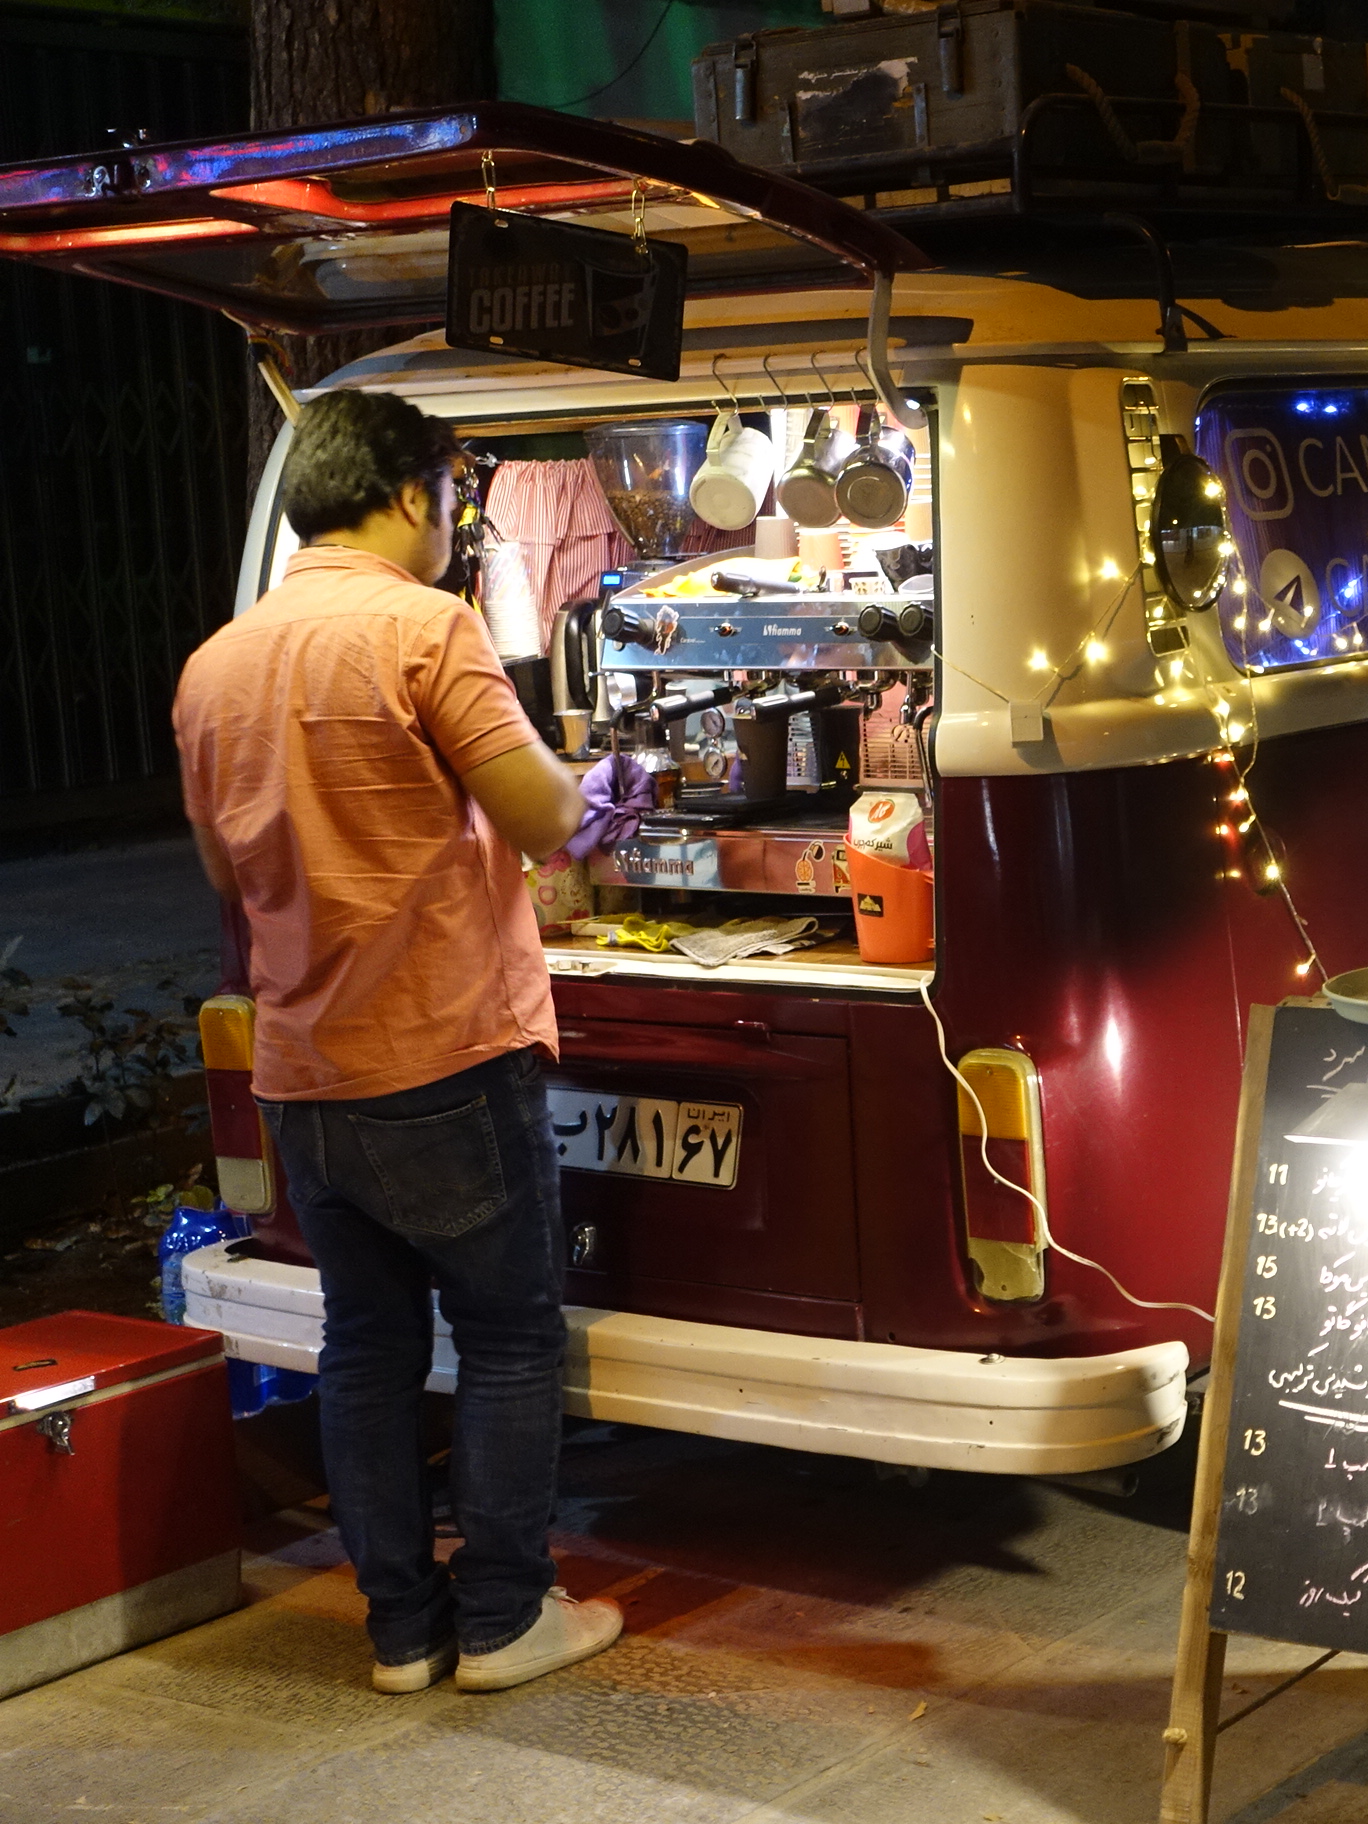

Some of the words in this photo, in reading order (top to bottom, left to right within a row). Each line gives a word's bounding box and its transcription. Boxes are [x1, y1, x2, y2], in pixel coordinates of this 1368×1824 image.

[469, 282, 575, 334] COFFEE
[688, 1108, 731, 1123] ایران
[1269, 1163, 1289, 1186] 11
[1256, 1255, 1278, 1279] 15
[1253, 1296, 1277, 1320] 13
[1244, 1429, 1267, 1456] 13
[1235, 1487, 1258, 1515] 13
[1226, 1570, 1246, 1600] 12
